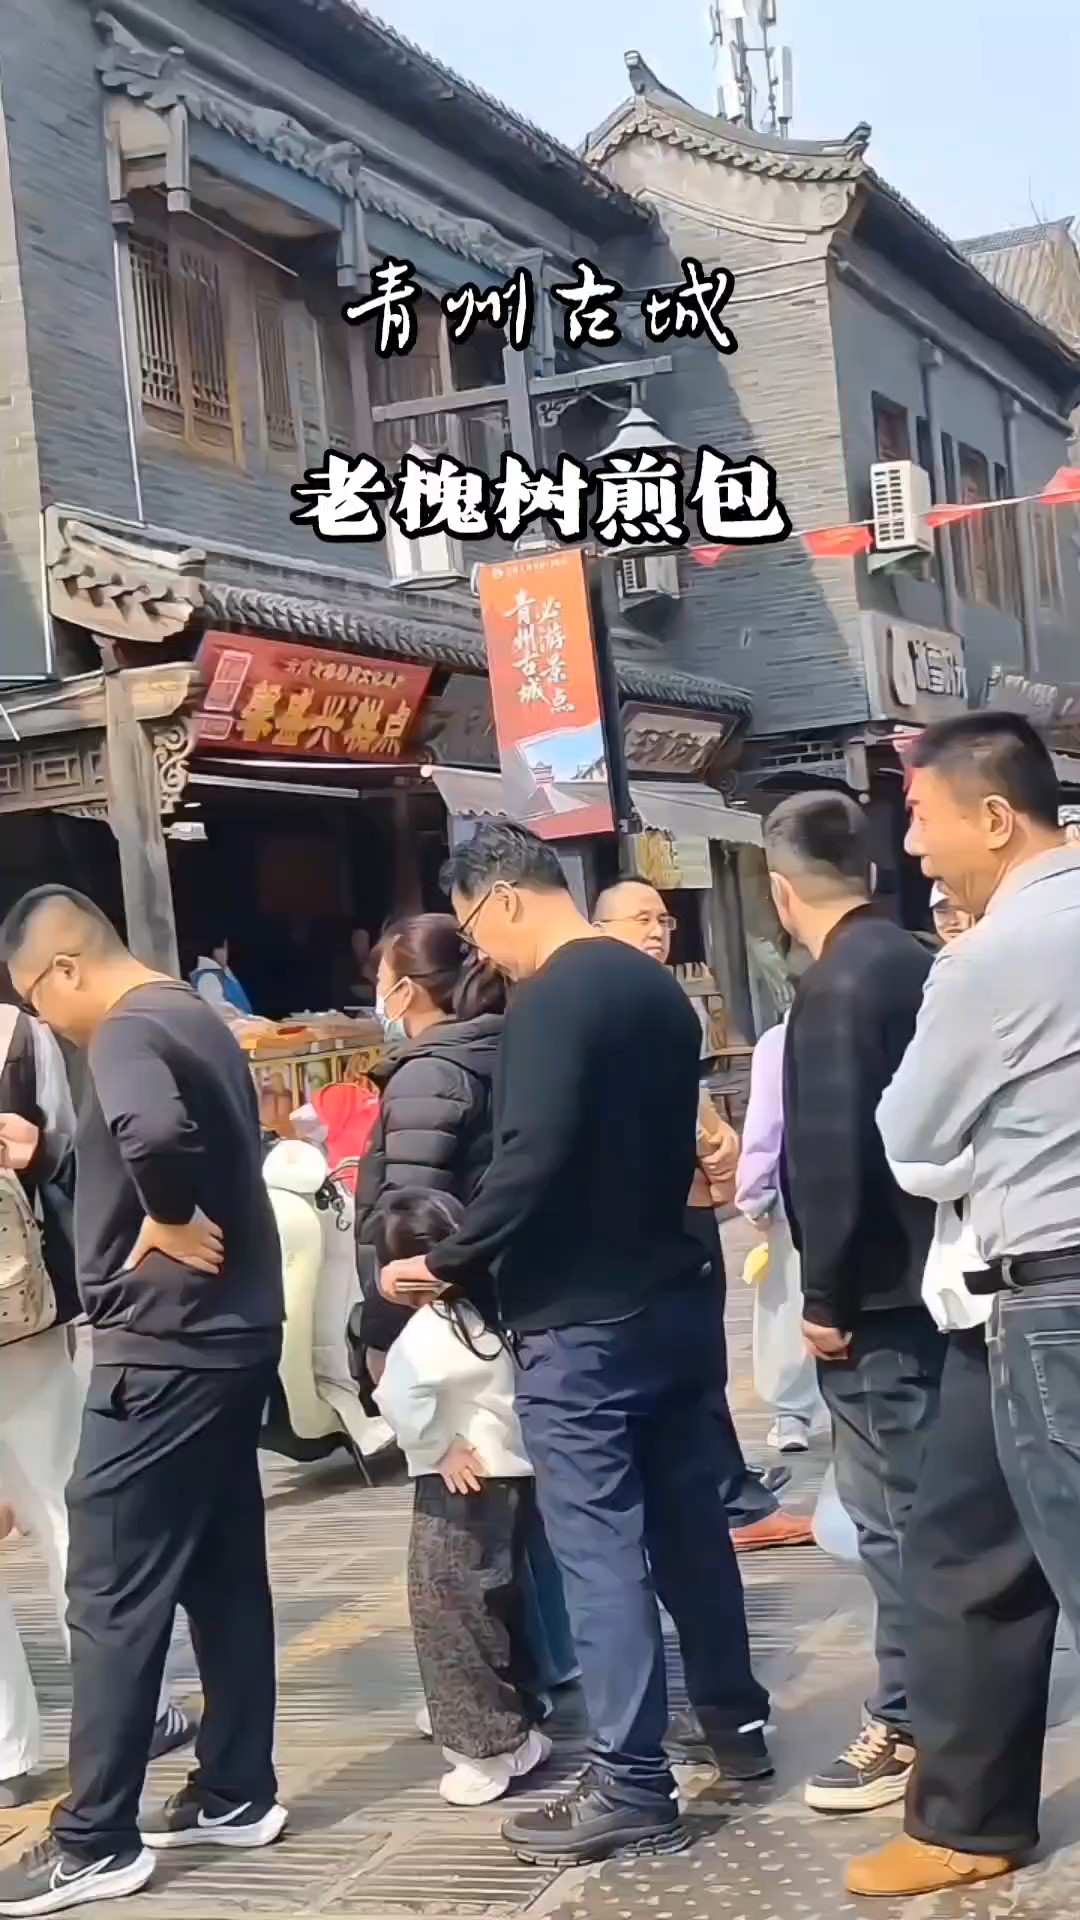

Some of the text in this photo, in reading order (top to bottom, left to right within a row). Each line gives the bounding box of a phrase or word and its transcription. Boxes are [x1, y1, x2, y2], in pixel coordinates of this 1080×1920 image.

[504, 589, 551, 704] 青州古城
[535, 596, 576, 713] 必游景点
